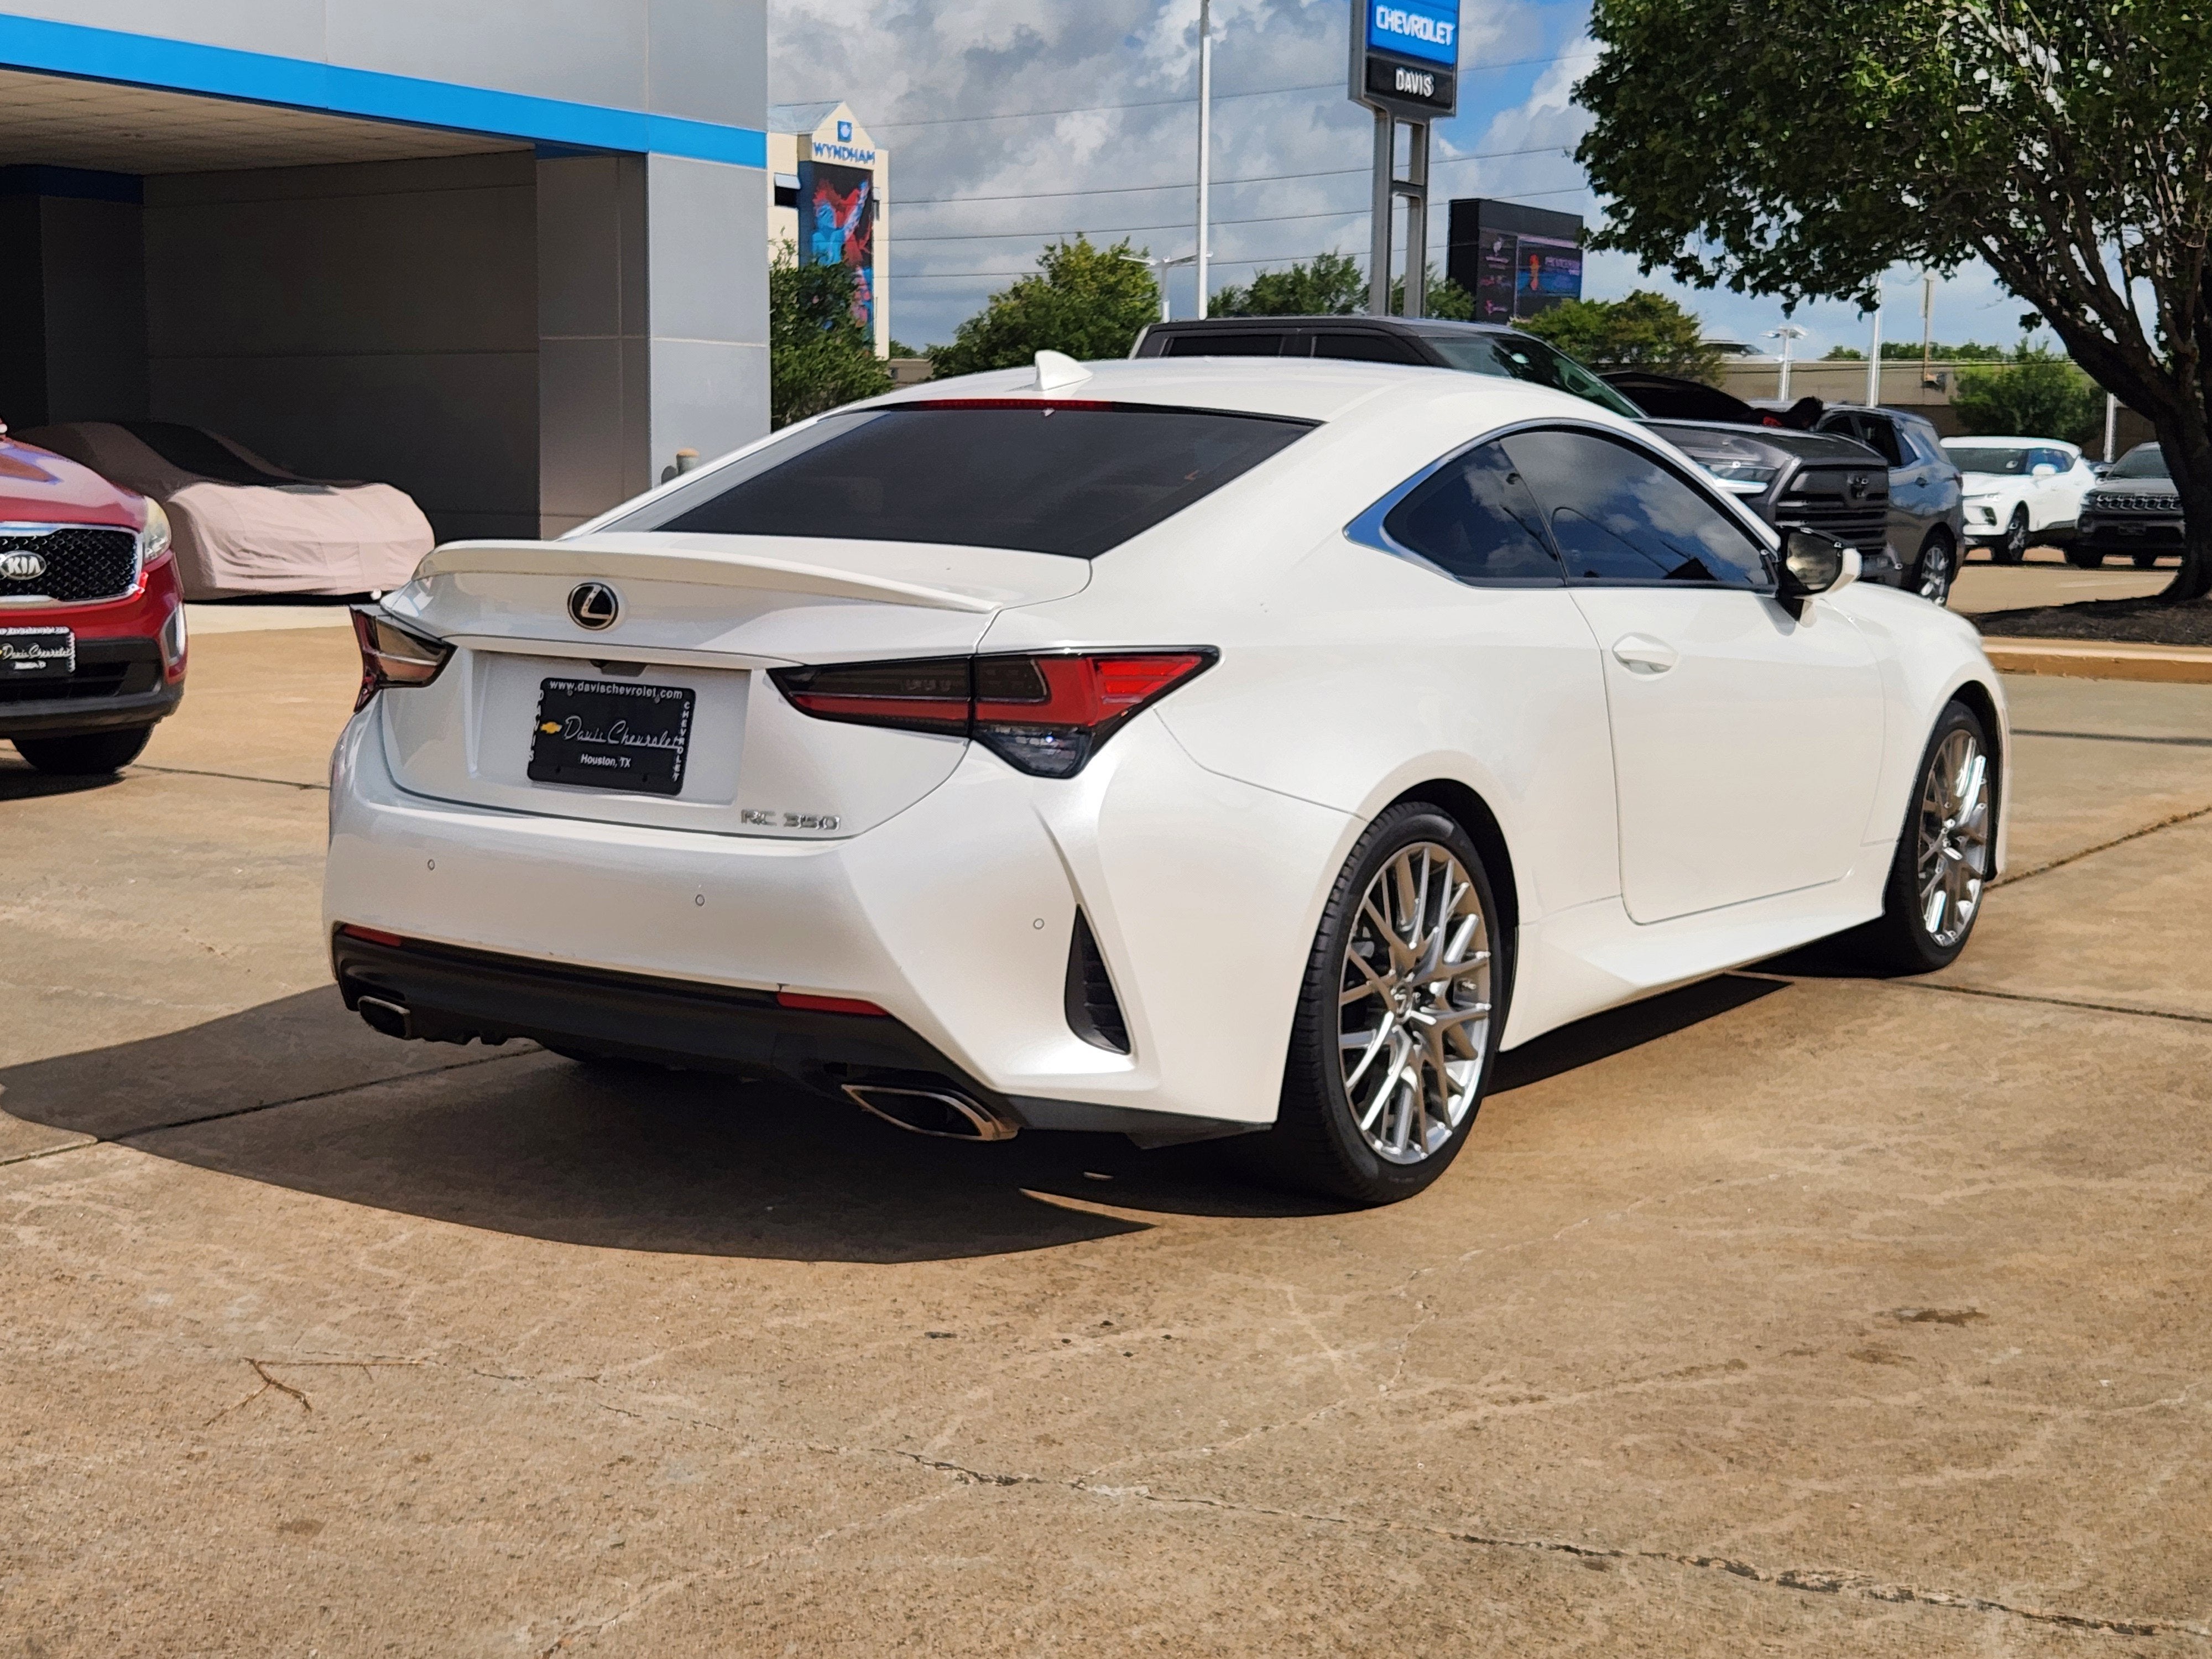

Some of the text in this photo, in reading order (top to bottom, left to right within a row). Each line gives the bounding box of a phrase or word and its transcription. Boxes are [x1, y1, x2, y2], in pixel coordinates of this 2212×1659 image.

[1375, 5, 1455, 46] CHEVROLET
[1395, 67, 1434, 97] DAVIS
[813, 142, 875, 165] WYNDHAM
[7, 556, 41, 575] KIA
[564, 715, 682, 750] Davis Chevrolet
[581, 753, 632, 768] Houston, TX
[741, 808, 841, 831] RC 350
